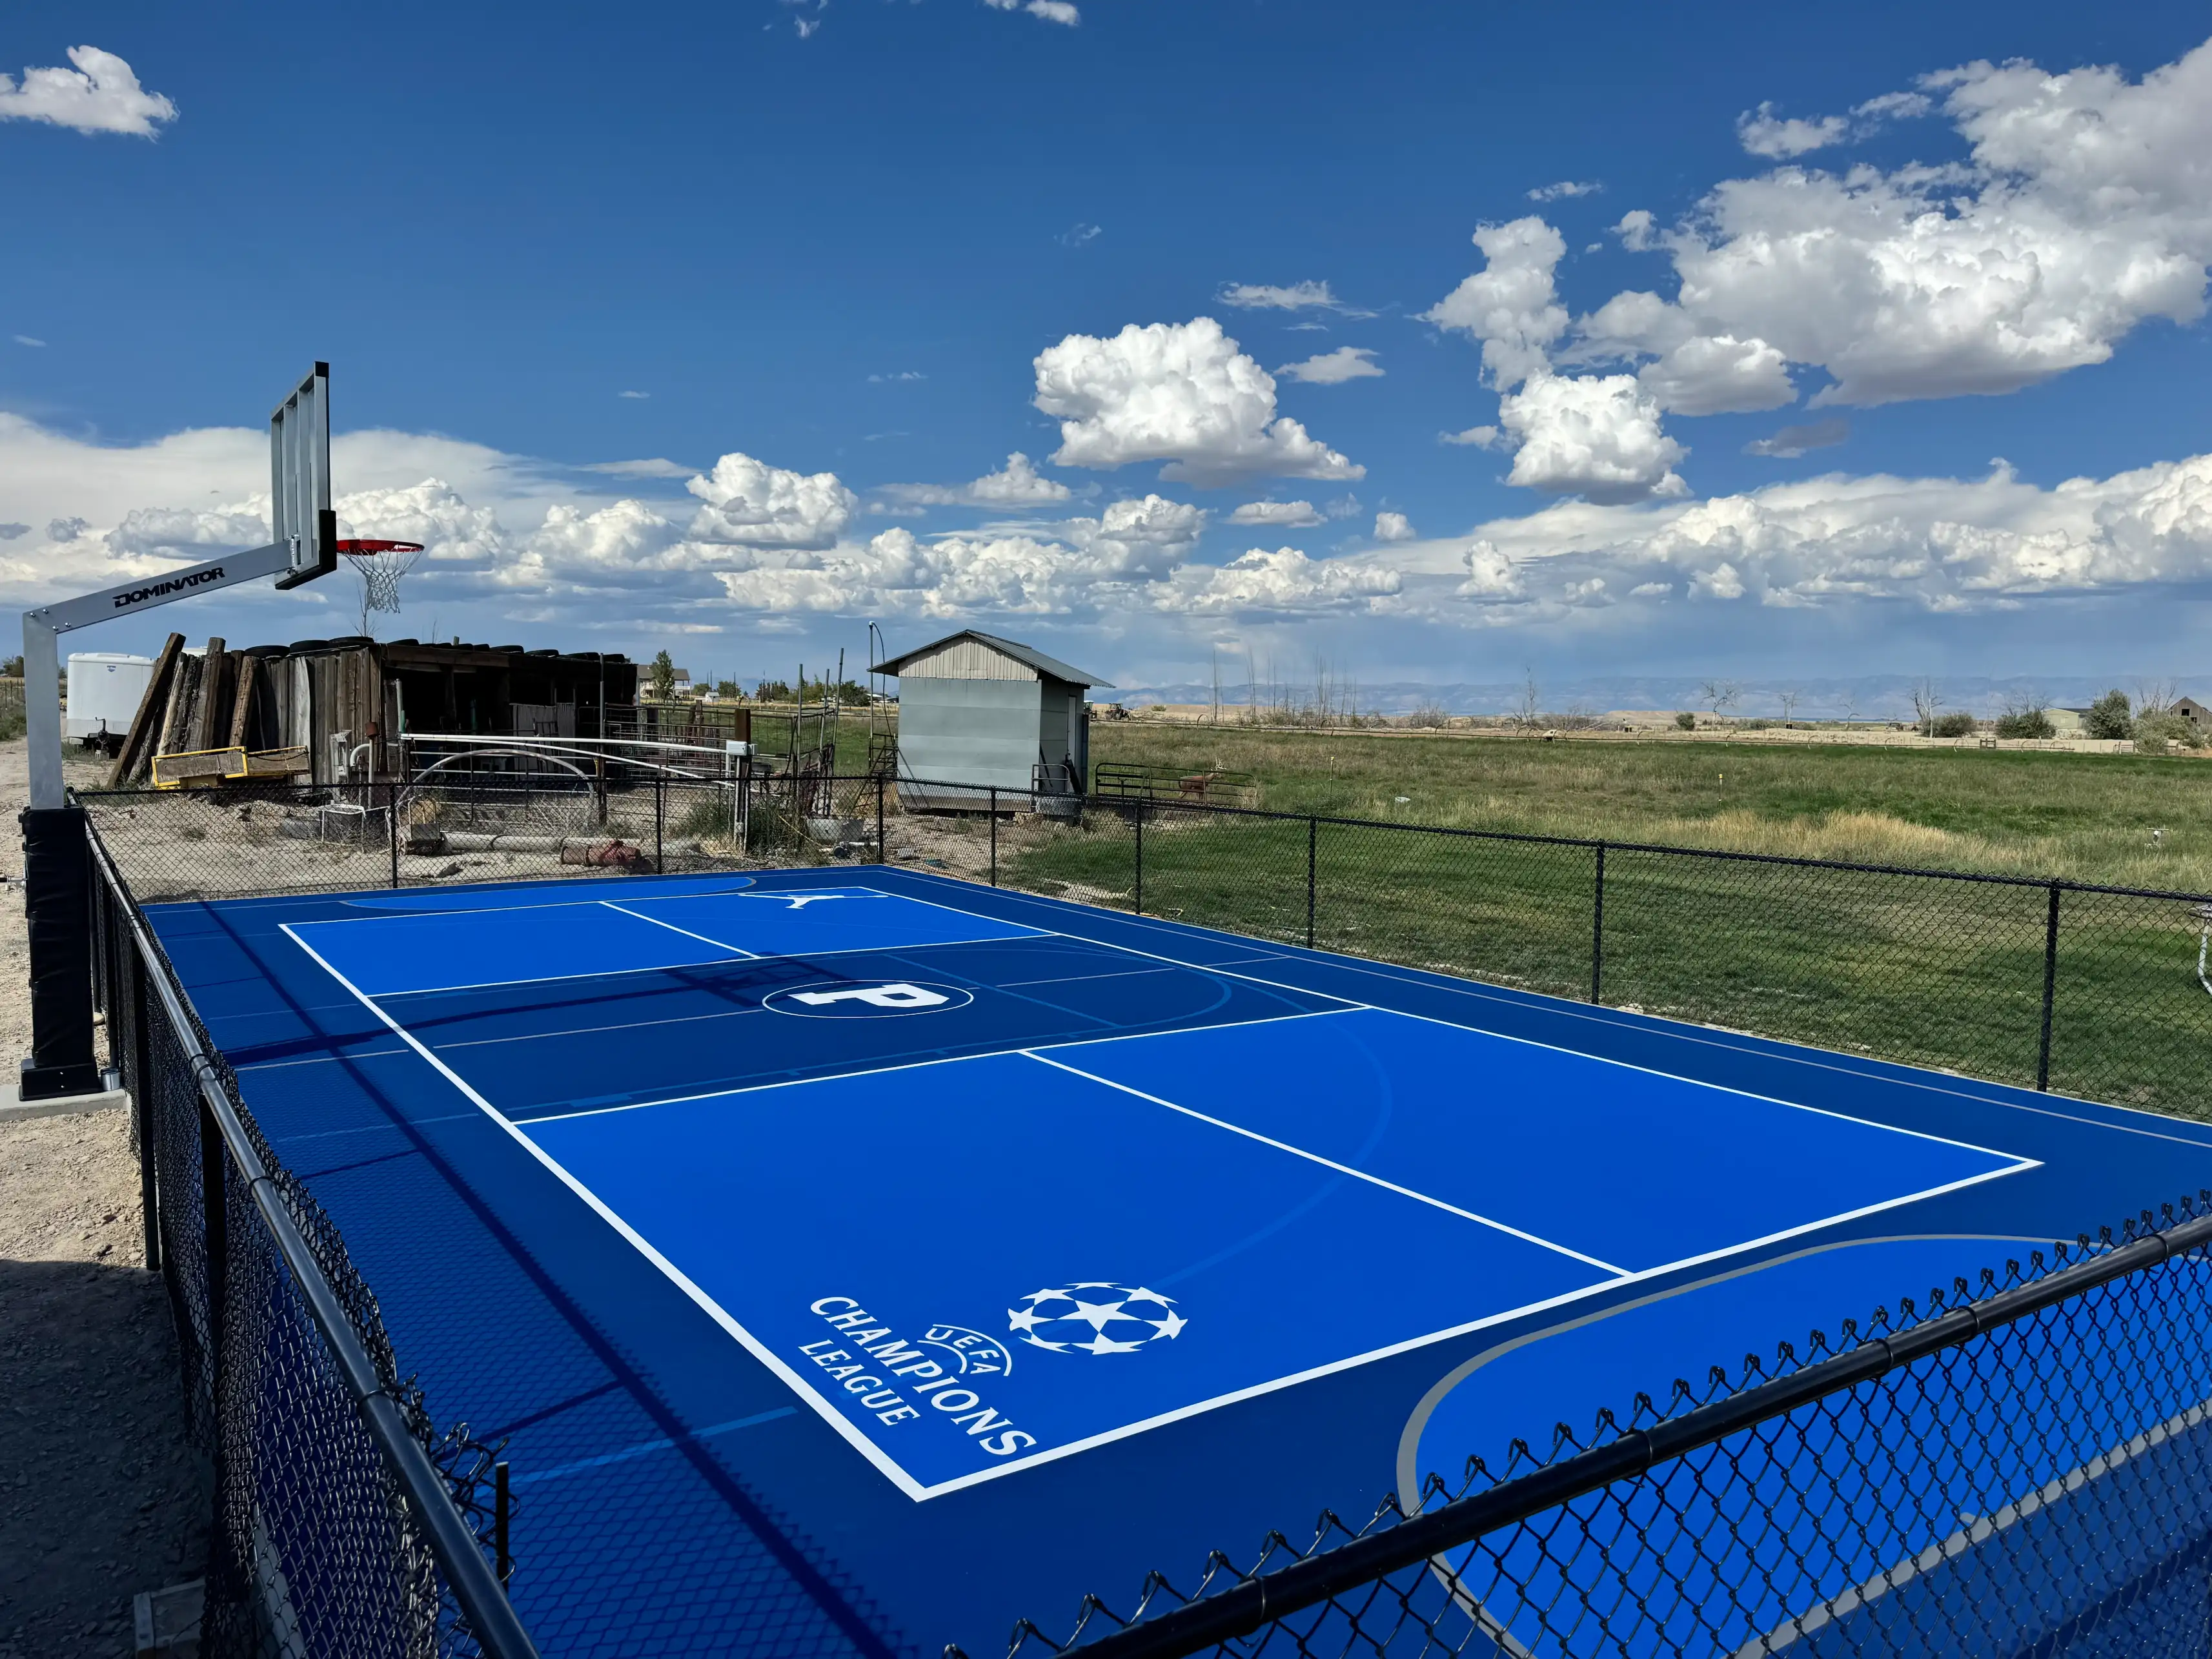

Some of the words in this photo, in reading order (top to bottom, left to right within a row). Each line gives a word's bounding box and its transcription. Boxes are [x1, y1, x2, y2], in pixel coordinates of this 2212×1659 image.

[112, 567, 225, 608] DOMINATOR
[798, 1339, 921, 1426] LEAGUE
[810, 1296, 1037, 1456] CHAMPIONS
[925, 1328, 1001, 1374] UEFA
